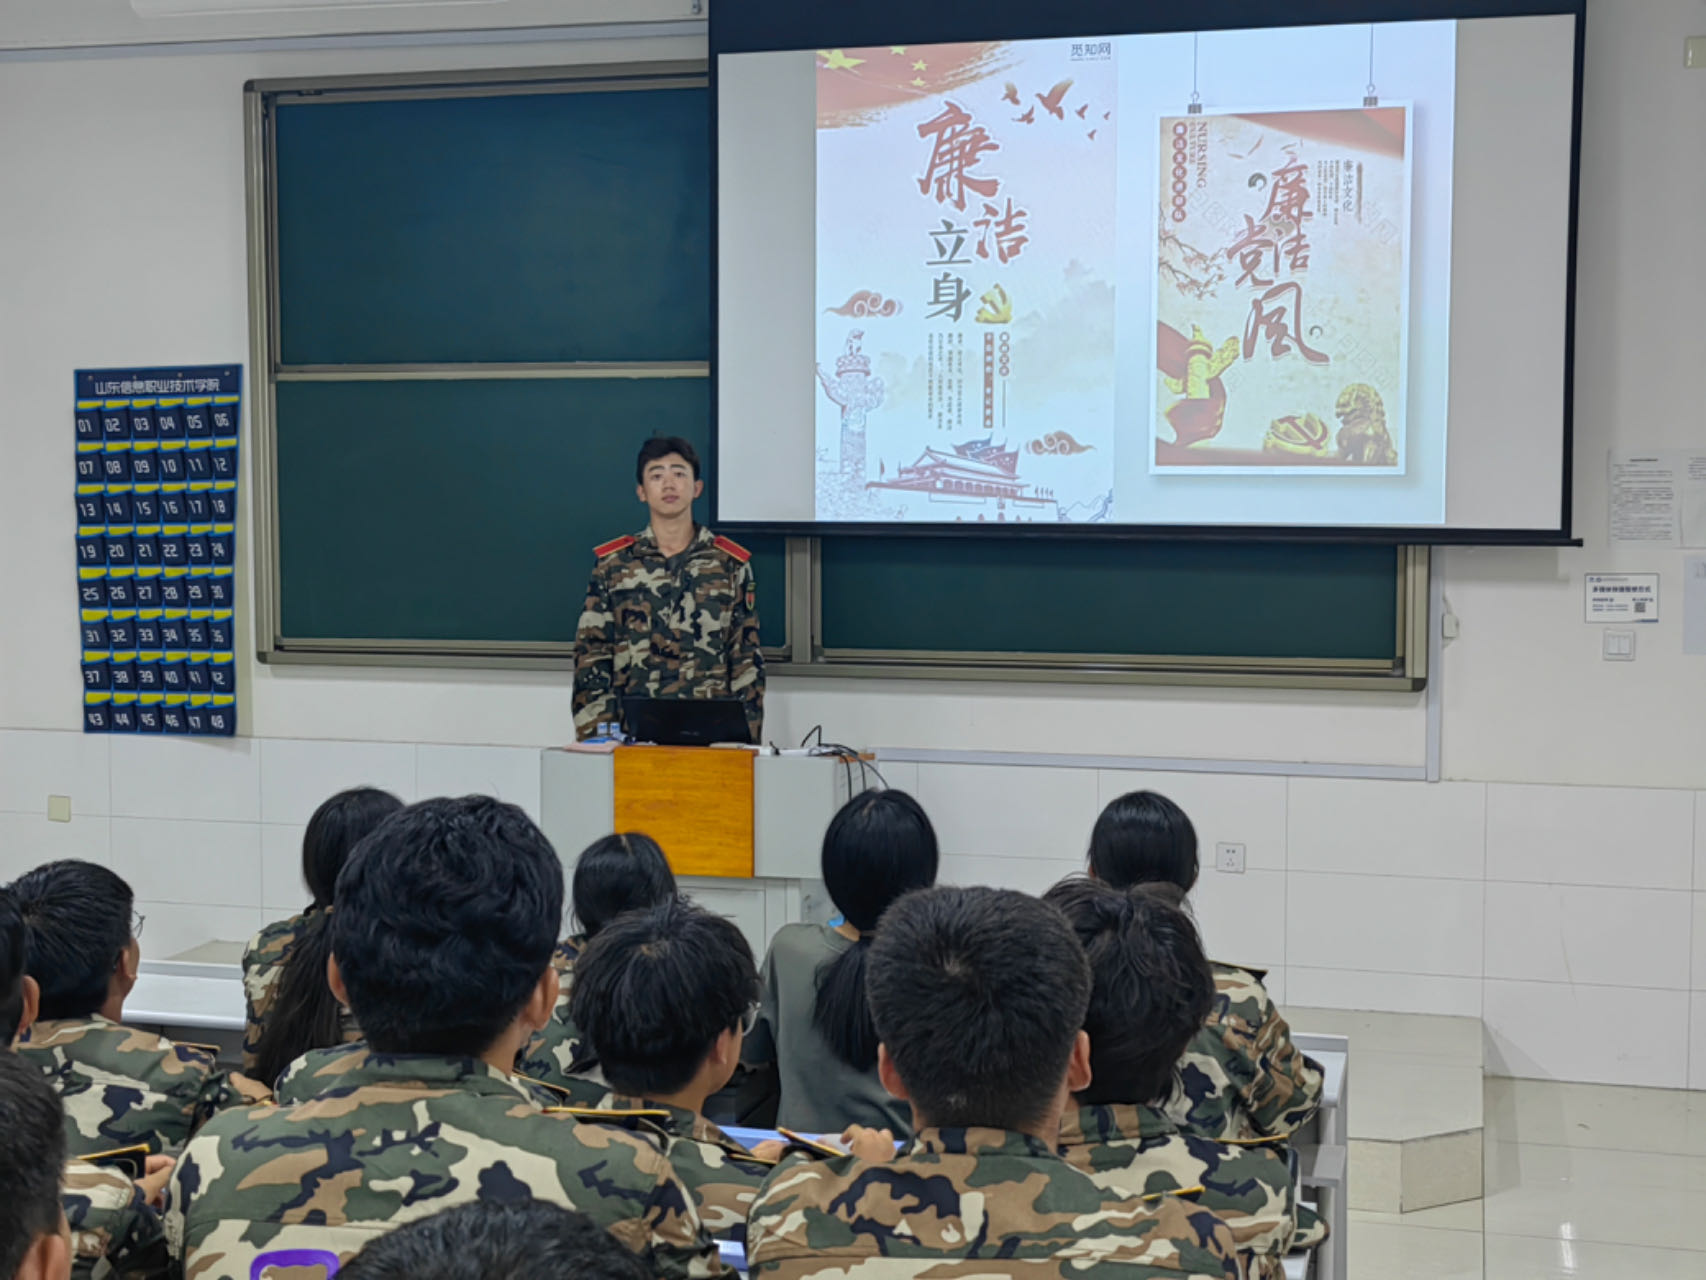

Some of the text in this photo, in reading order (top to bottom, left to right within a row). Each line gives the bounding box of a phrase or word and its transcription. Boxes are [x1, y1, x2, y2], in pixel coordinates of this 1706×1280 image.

[1071, 42, 1112, 56] 觅知网
[1197, 121, 1207, 189] NURSING
[917, 100, 1029, 264] 廉洁
[925, 219, 972, 323] 立身
[95, 378, 220, 395] 山东信息职业技术学院
[78, 413, 229, 433] 01 02 03 04 05 06
[79, 458, 227, 475] 07 08 09 10 11 12
[80, 500, 226, 517] 13 14 15 16 17 18
[80, 545, 96, 559] 19
[108, 545, 125, 558] 20
[138, 544, 151, 557] 21
[162, 544, 178, 557] 22
[188, 544, 203, 556] 23
[82, 588, 99, 601] 25
[109, 586, 126, 600] 26
[137, 587, 151, 600] 27
[163, 586, 178, 599] 28
[188, 585, 203, 598] 29
[85, 629, 100, 642] 31
[111, 629, 127, 642] 32
[138, 629, 154, 641] 33
[162, 629, 178, 641] 34
[85, 670, 100, 683] 37
[113, 671, 129, 683] 38
[139, 670, 154, 683] 39
[88, 713, 103, 726] 43
[140, 713, 155, 726] 45
[188, 716, 201, 728] 47
